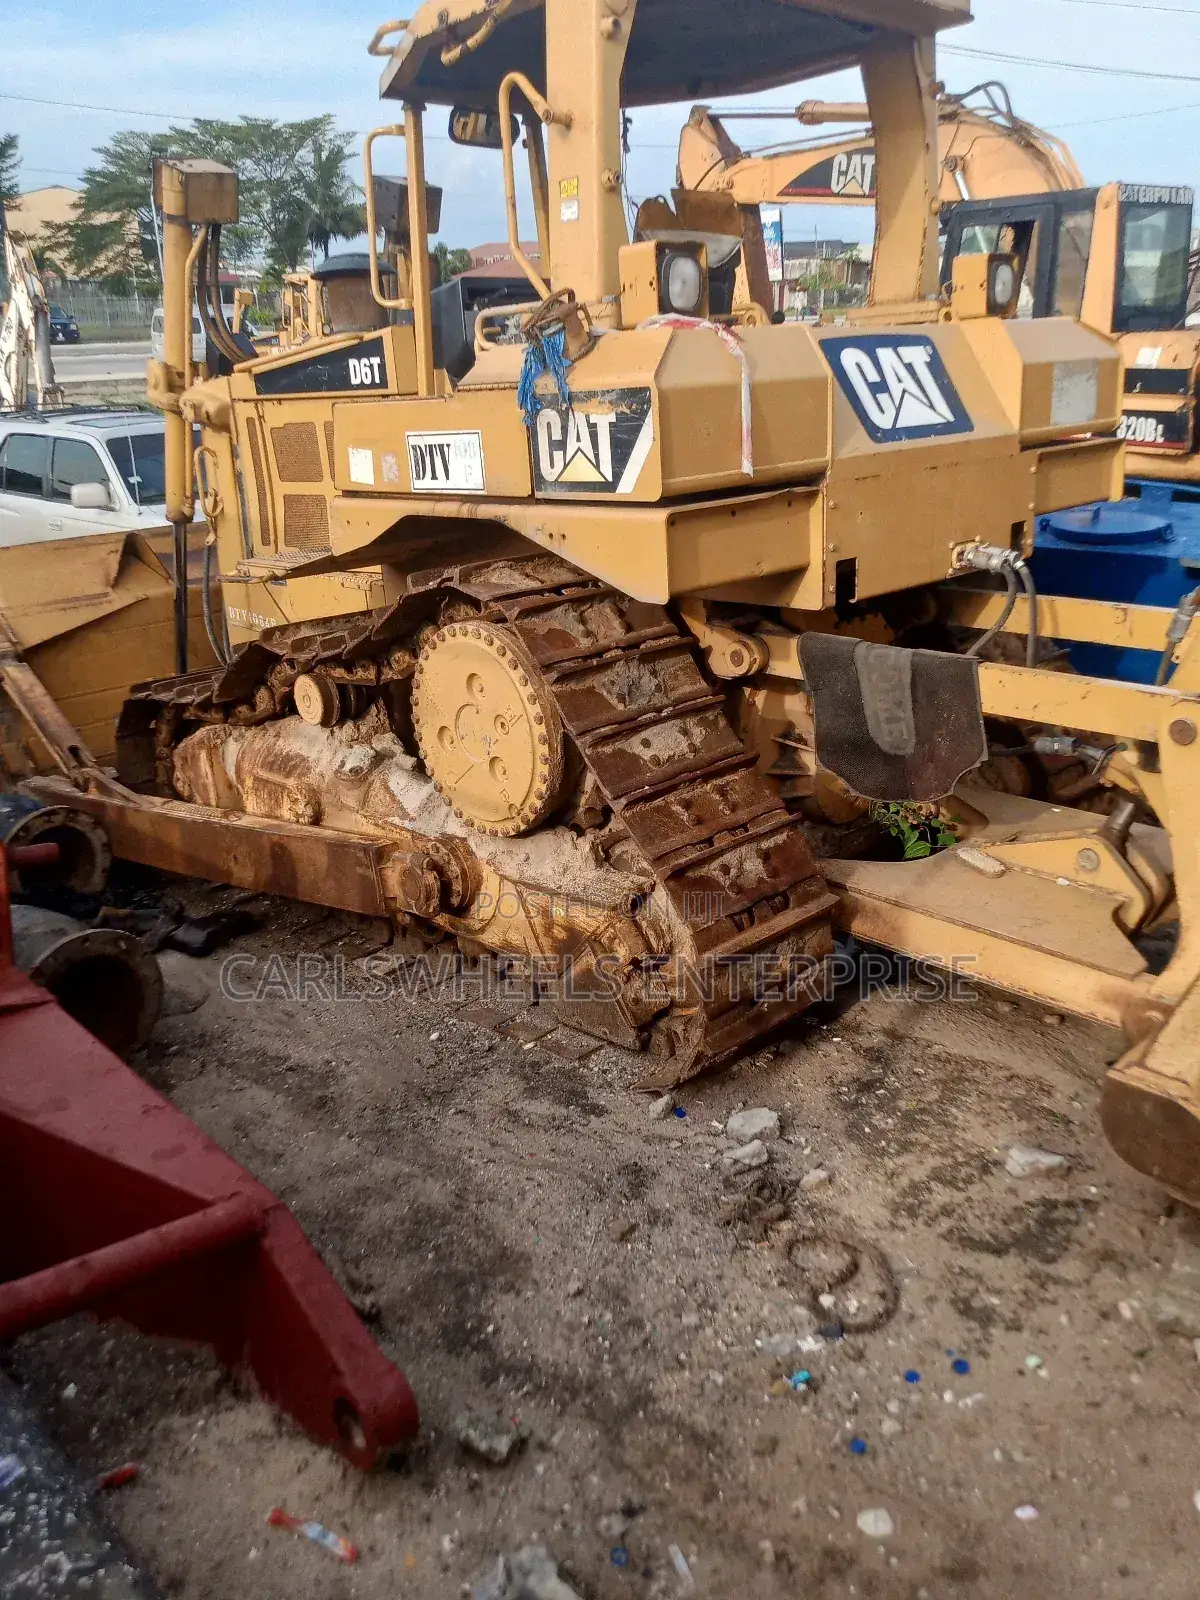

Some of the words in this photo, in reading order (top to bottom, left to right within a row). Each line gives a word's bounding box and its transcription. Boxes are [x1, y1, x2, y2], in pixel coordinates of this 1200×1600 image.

[831, 153, 876, 196] CAT
[348, 356, 381, 386] D6T
[840, 345, 955, 430] CAT
[411, 443, 451, 481] DTV
[536, 408, 617, 482] CAT
